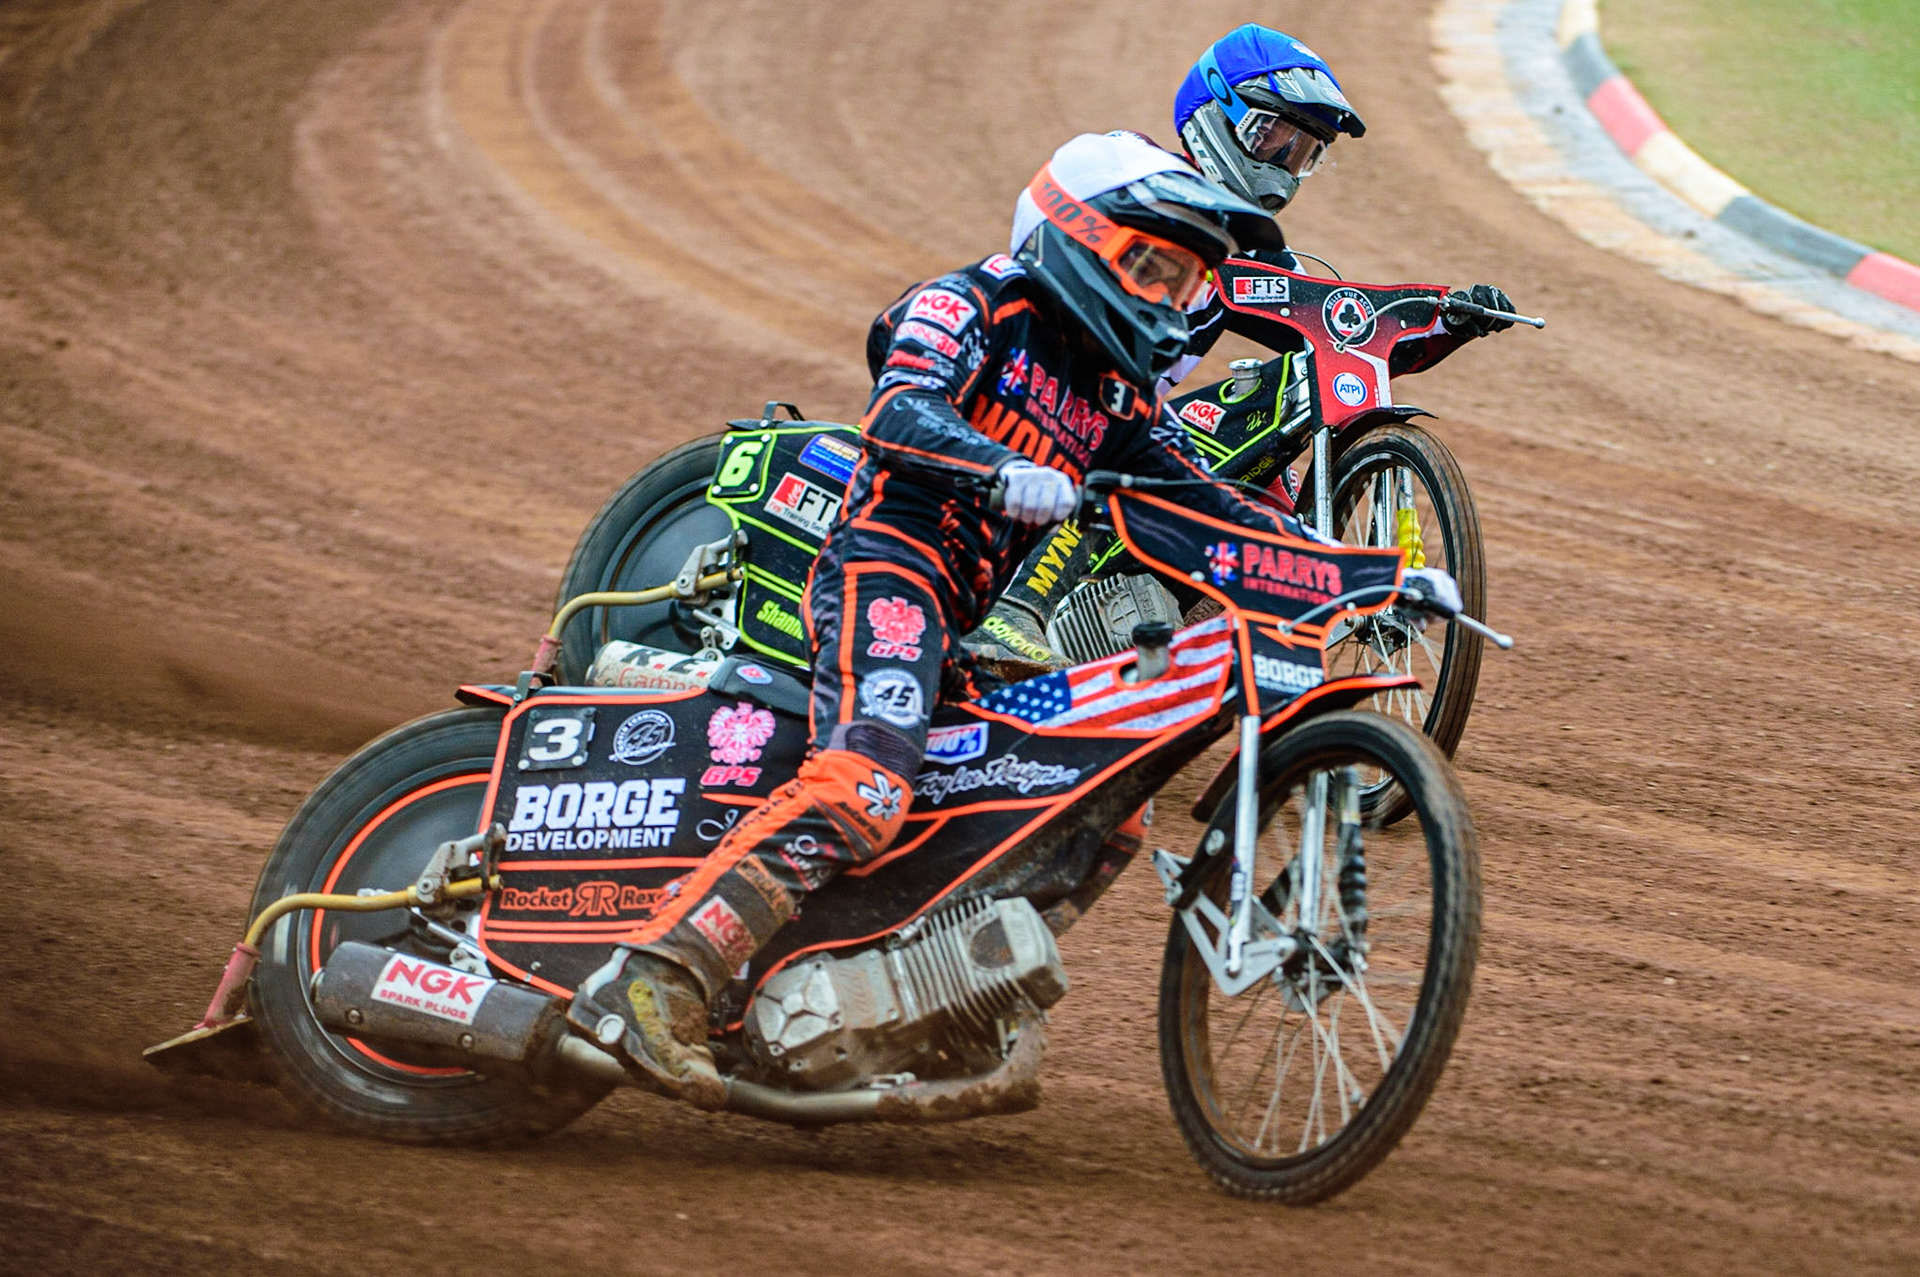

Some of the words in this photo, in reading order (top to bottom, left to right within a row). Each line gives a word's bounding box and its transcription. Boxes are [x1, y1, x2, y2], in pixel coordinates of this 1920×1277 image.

[1252, 278, 1286, 294] FTS
[915, 293, 970, 322] NGK
[1343, 291, 1359, 299] VUE
[1359, 297, 1373, 315] ACES
[1340, 383, 1361, 396] ATPI
[1029, 361, 1109, 451] PARRYS
[1186, 402, 1221, 426] NGK
[718, 441, 764, 487] 6
[796, 486, 837, 527] FT
[1242, 543, 1343, 597] PARRYS
[867, 641, 924, 662] GPS
[982, 615, 1050, 662] daytona
[1253, 653, 1324, 688] BORGE
[528, 718, 583, 761] 3
[700, 765, 762, 787] GPS
[508, 778, 686, 832] BORGE
[505, 827, 676, 851] DEVELOPMENT
[502, 888, 572, 909] Rocket
[387, 960, 484, 1005] NGK
[380, 988, 420, 1008] SPARK
[424, 1000, 468, 1019] PLUGS
